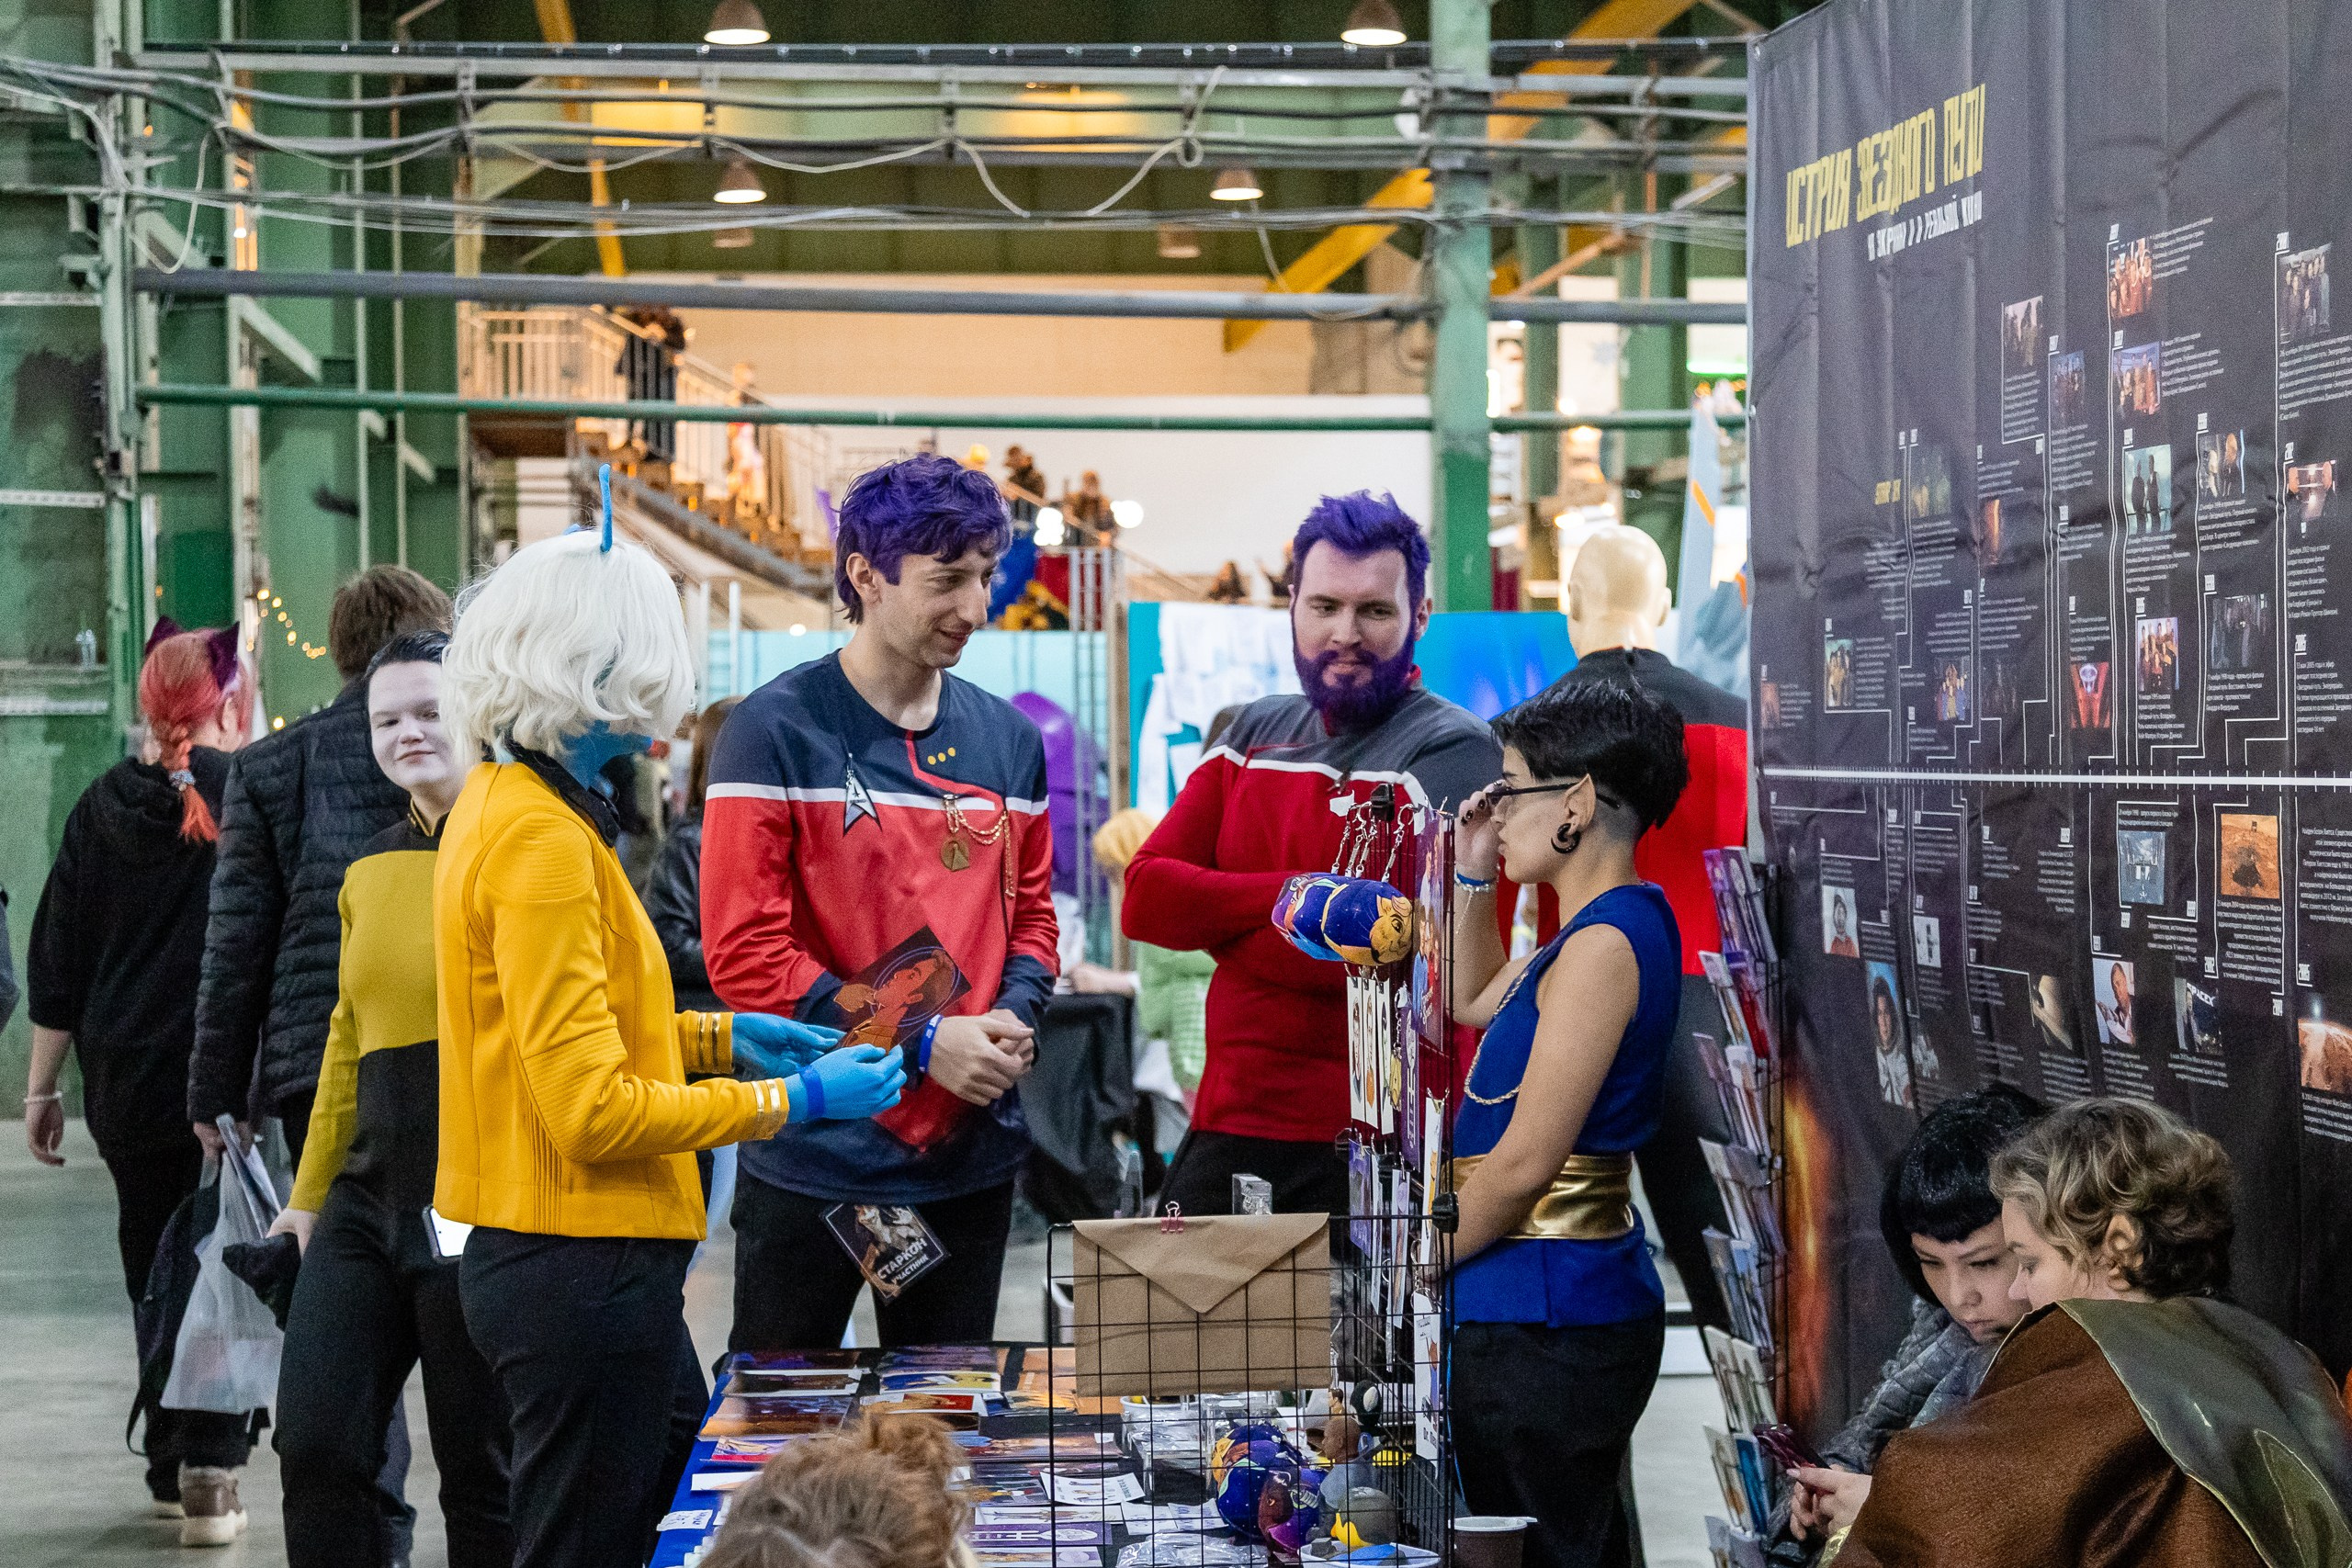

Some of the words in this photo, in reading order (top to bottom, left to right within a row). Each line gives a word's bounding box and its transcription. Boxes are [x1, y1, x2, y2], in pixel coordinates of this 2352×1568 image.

[1943, 83, 1985, 186] ПУТИ
[2187, 982, 2215, 1007] SPACEX
[876, 1237, 928, 1280] СТАРКОН
